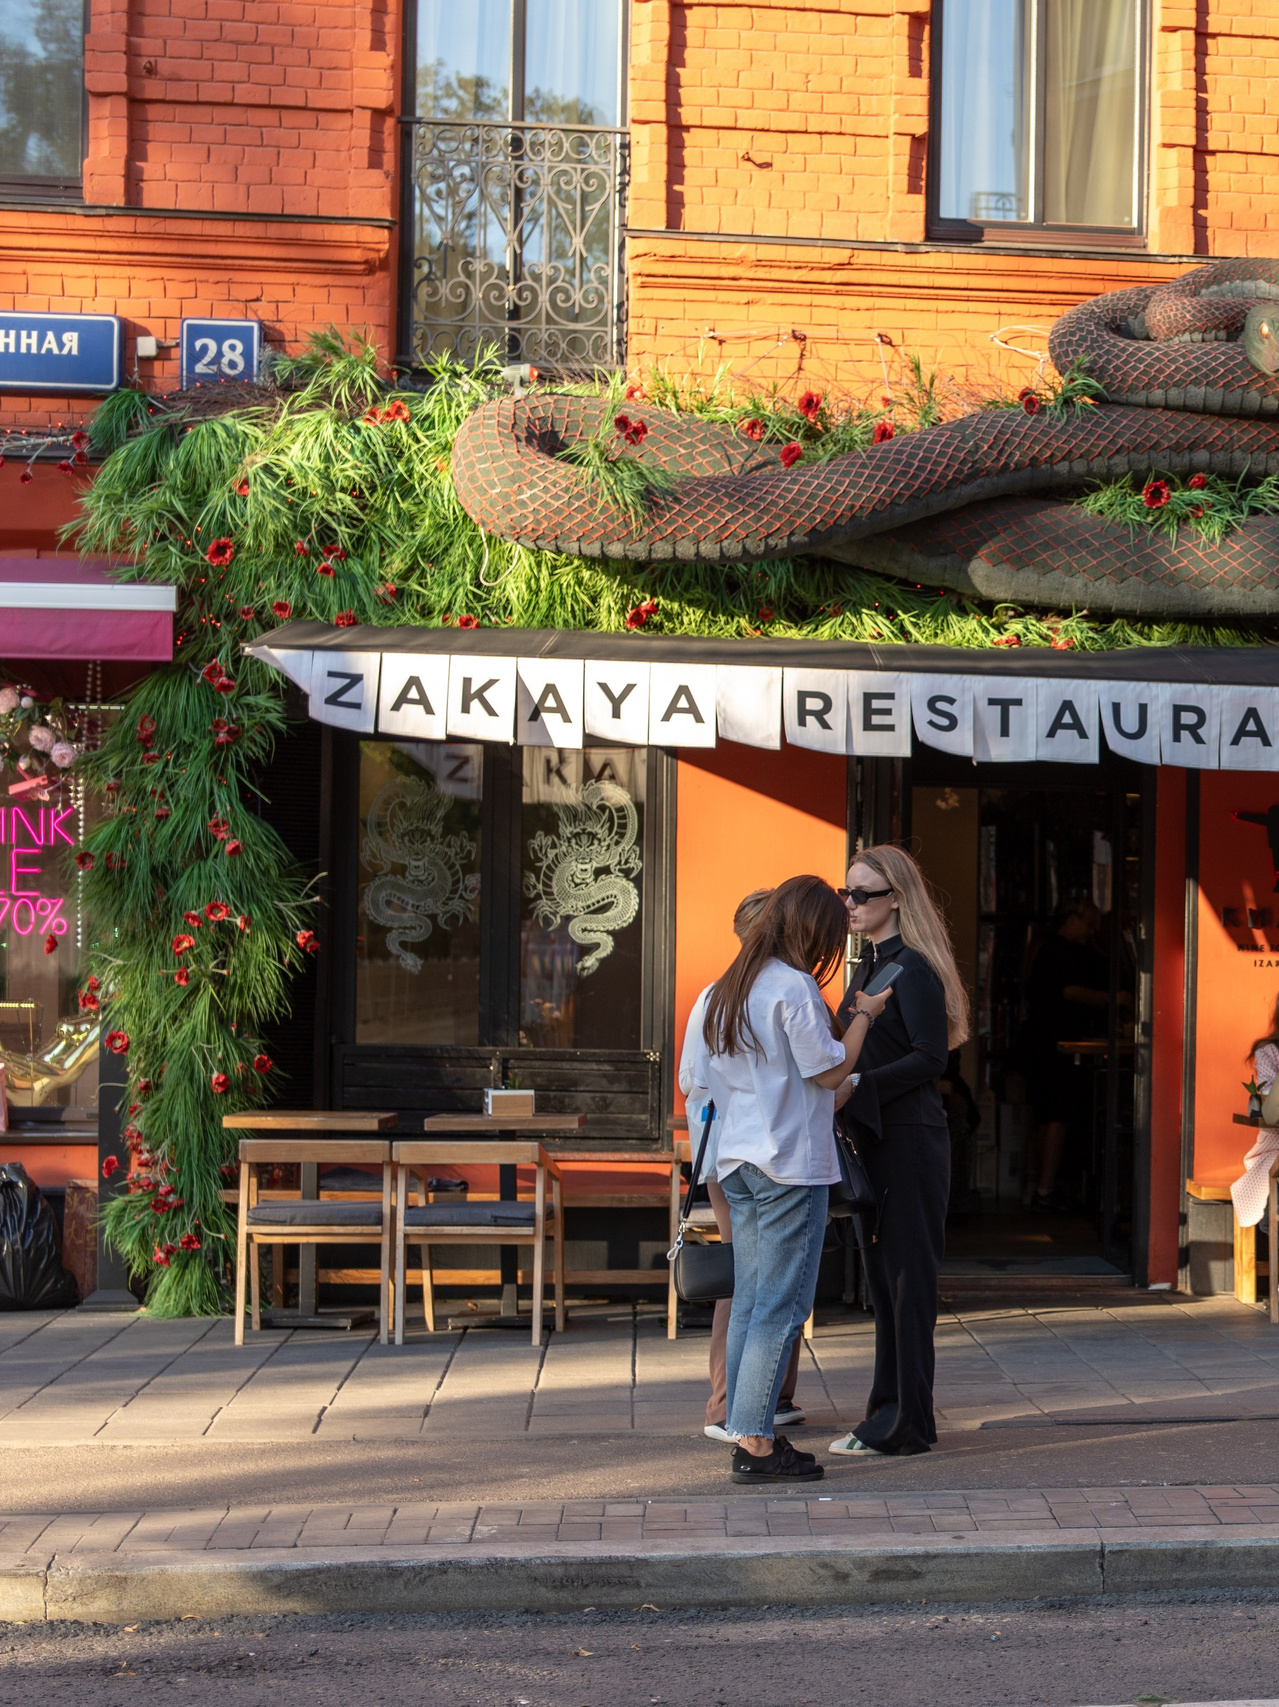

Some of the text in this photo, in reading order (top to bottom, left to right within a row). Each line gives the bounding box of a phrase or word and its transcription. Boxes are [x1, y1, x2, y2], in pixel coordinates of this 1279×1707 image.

[194, 337, 245, 376] 28
[324, 671, 706, 724] ZAKAYA
[0, 848, 41, 896] E
[1237, 944, 1265, 952] WINE
